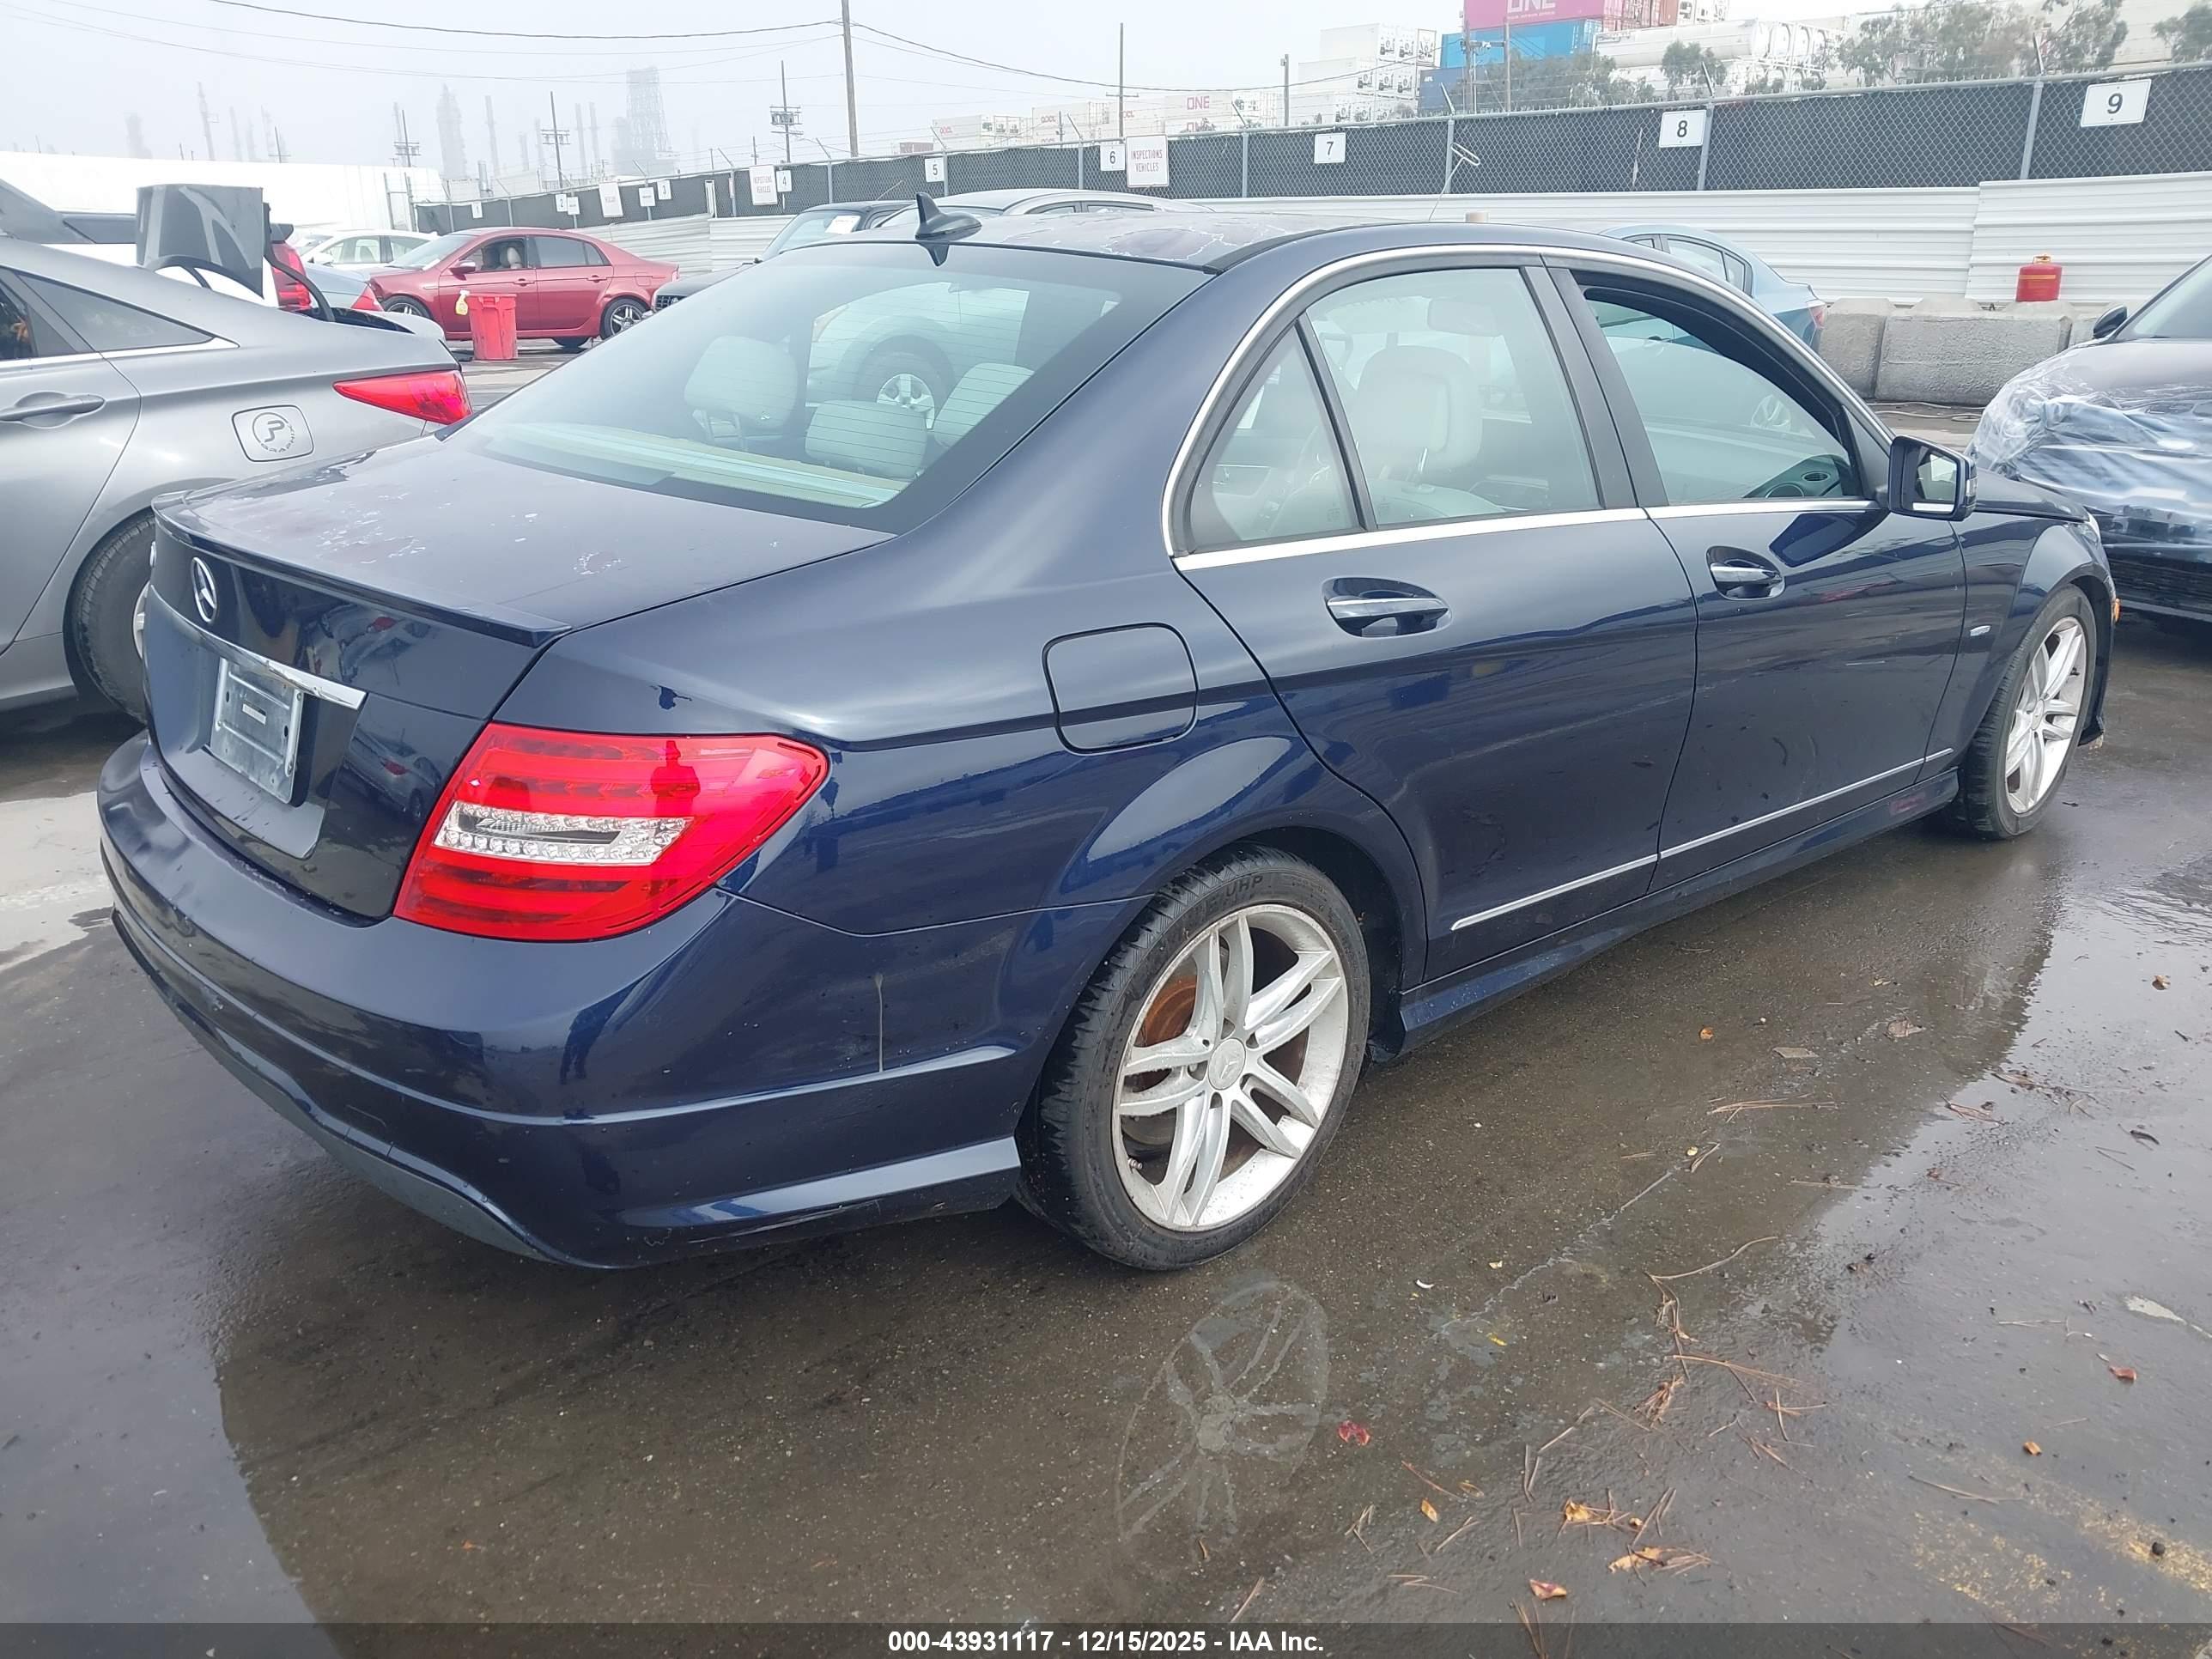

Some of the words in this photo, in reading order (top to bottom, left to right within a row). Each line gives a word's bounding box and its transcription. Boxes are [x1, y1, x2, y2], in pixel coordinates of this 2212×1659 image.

[1187, 96, 1210, 111] ONE
[2107, 93, 2124, 114] 9
[1677, 120, 1688, 137] 8
[1327, 141, 1334, 155] 7
[1109, 151, 1115, 164] 6
[1130, 149, 1163, 160] INSPECTIONS
[933, 164, 939, 176] 5
[1134, 162, 1159, 173] VEHICLES
[782, 176, 787, 186] 4
[560, 198, 564, 208] 2
